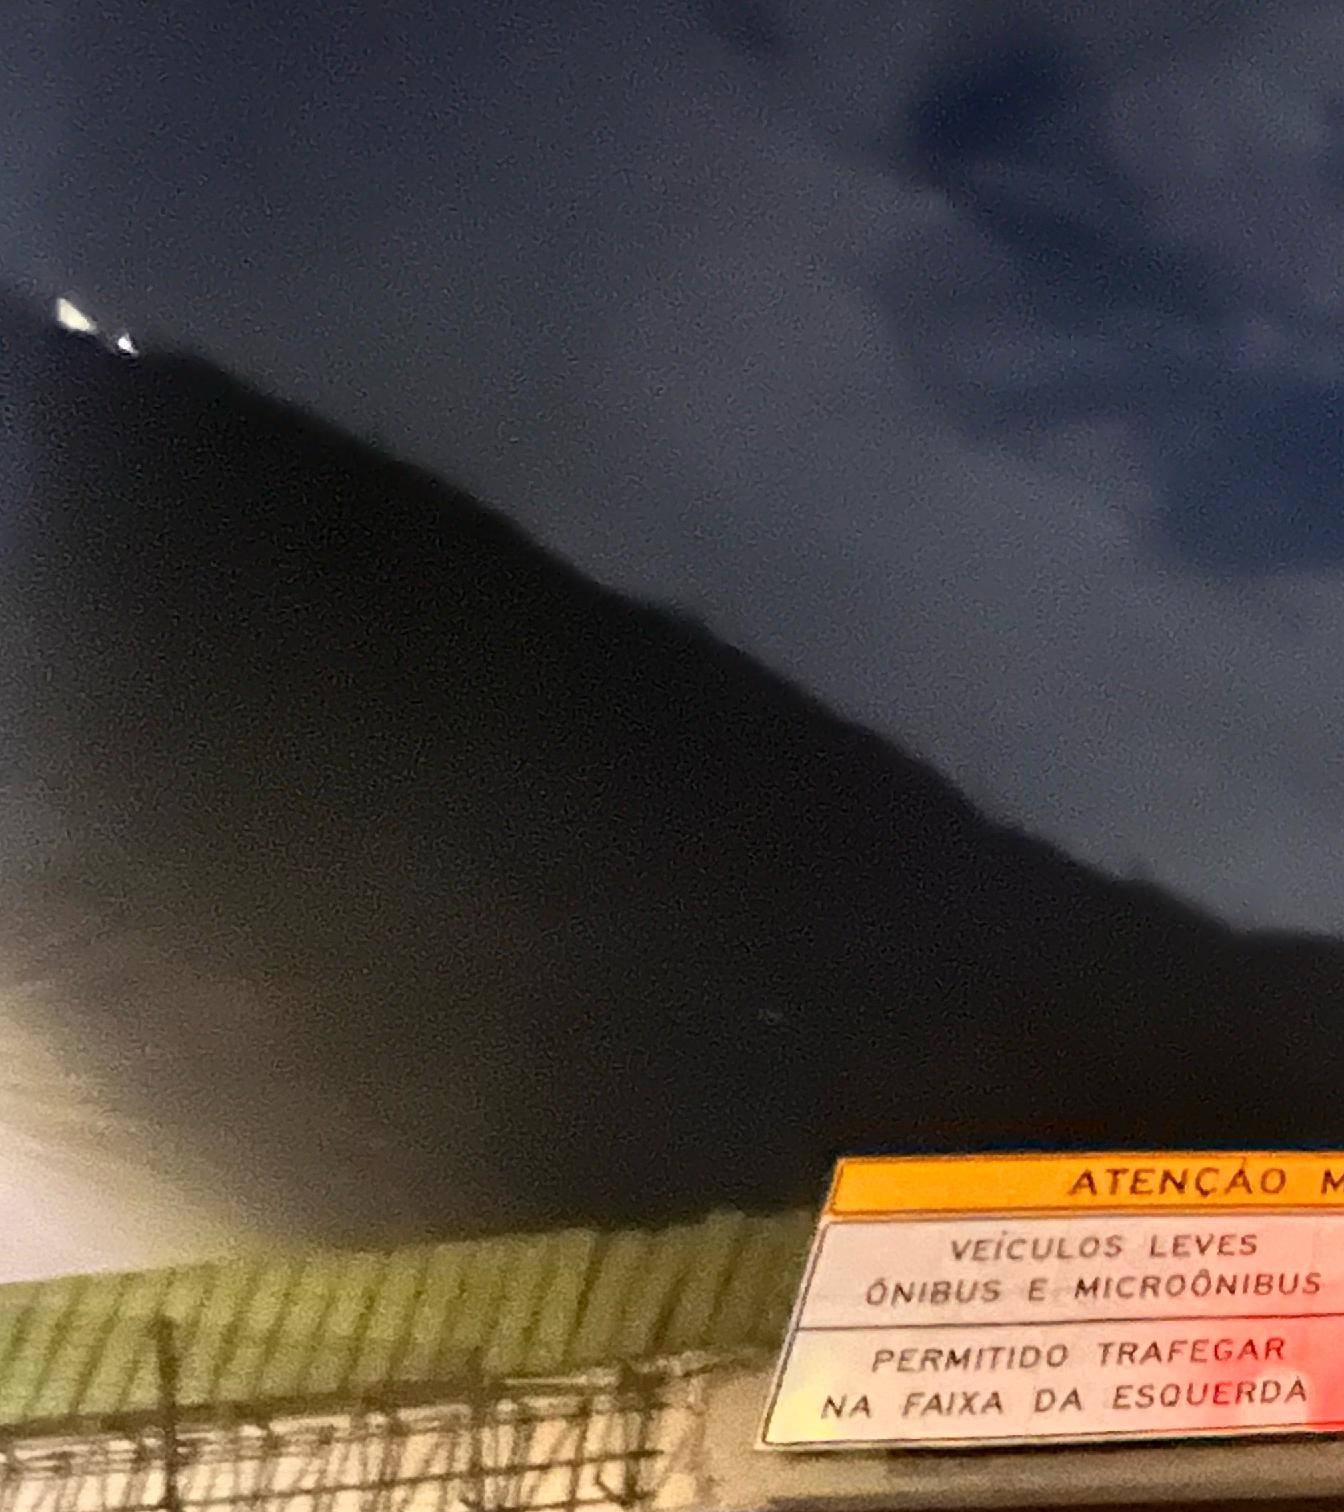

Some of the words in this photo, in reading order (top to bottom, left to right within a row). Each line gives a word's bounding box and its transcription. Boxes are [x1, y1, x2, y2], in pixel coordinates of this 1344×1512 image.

[1068, 1158, 1288, 1197] ATENÇÃO
[950, 1231, 1124, 1262] VEÍCULOS
[1150, 1233, 1258, 1257] LEVES
[865, 1273, 1000, 1306] ÔNIBUS
[1028, 1278, 1048, 1301] E
[1073, 1267, 1323, 1301] MICROÔNIBUS
[870, 1344, 1070, 1373] PERMITIDO
[1098, 1337, 1287, 1367] TRAFEGAR
[819, 1395, 873, 1420] NA
[902, 1390, 1004, 1418] FAIXA
[1033, 1387, 1084, 1413] DA
[1111, 1376, 1309, 1411] ESQUERDA
